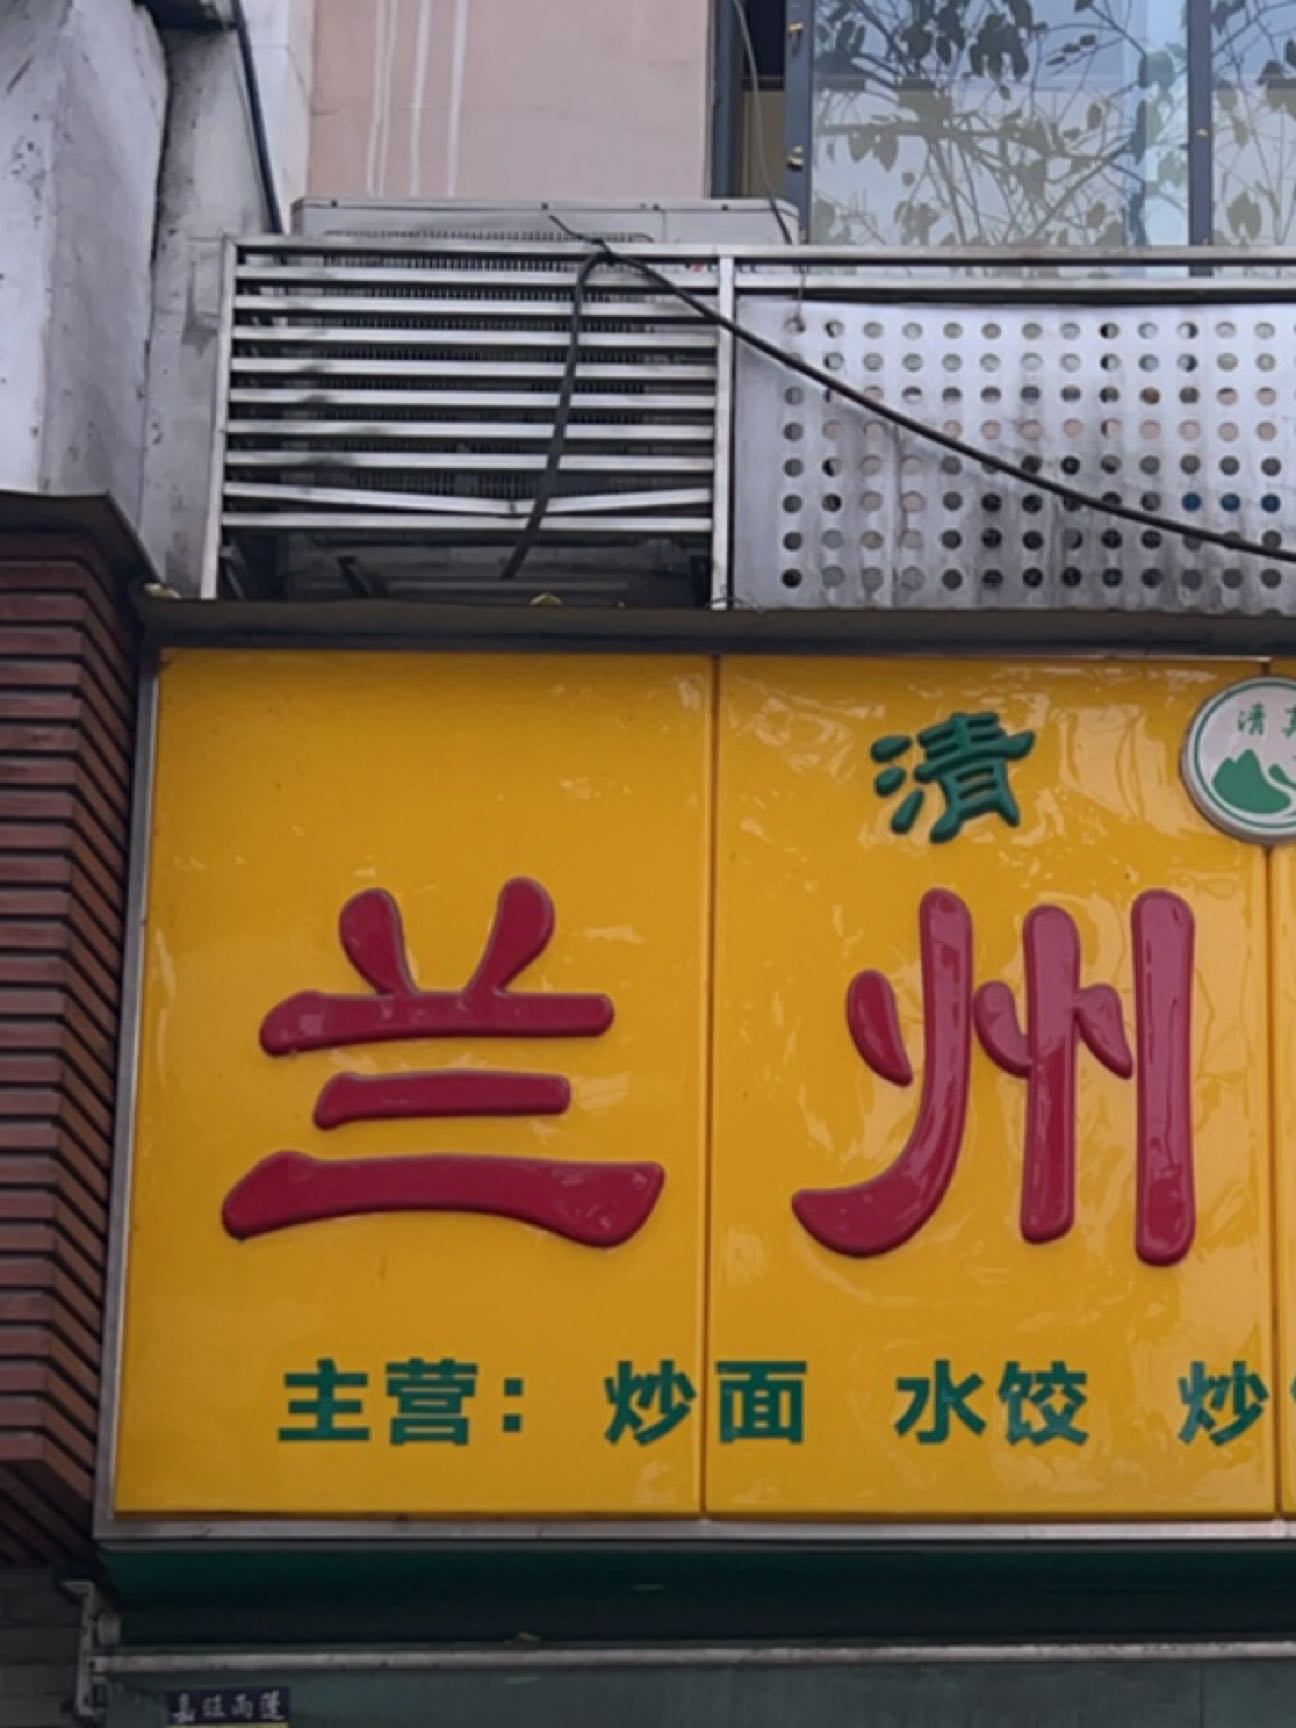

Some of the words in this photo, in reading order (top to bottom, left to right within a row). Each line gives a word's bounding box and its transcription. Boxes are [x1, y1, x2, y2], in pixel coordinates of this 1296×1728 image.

[873, 711, 1035, 843] 清
[604, 1360, 807, 1446] 炒面
[895, 1360, 1088, 1446] 水饺
